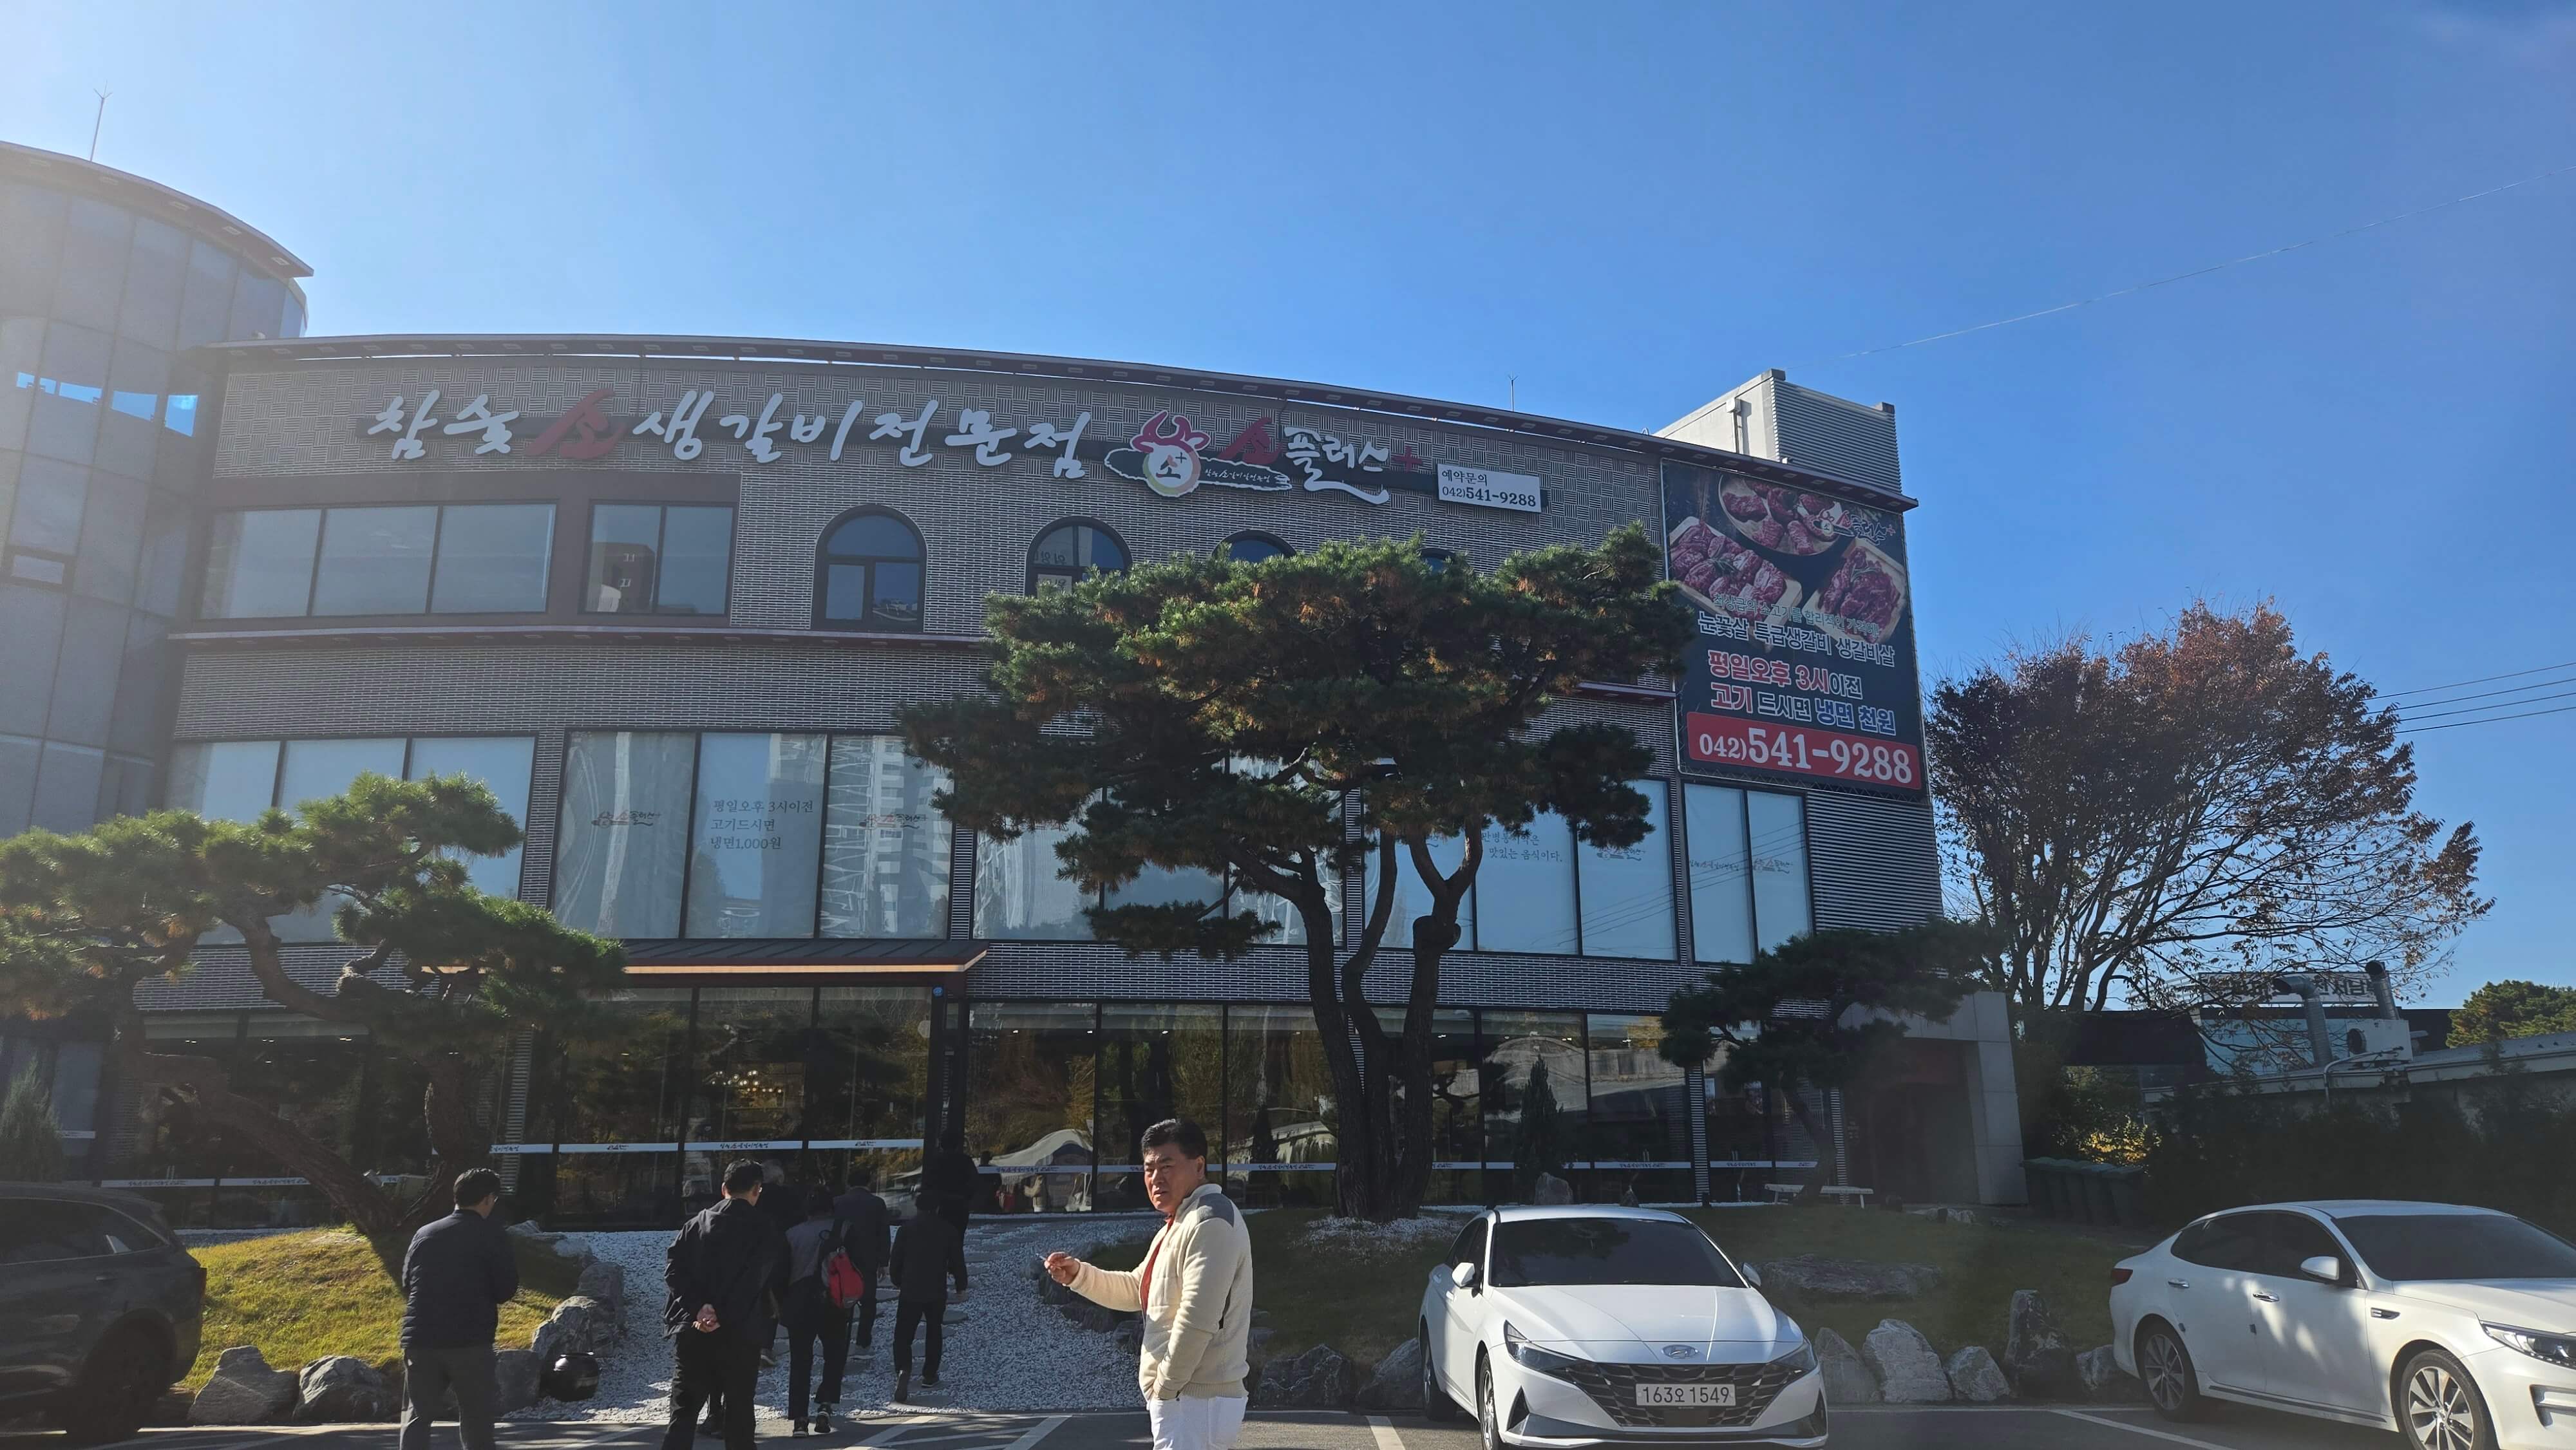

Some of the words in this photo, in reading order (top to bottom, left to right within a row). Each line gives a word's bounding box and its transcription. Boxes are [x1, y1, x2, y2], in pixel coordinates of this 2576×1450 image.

[1441, 469, 1488, 486] 예약문의
[1442, 485, 1537, 507] 042)541-9288
[1759, 601, 1802, 623] 소고기를
[1804, 610, 1845, 630] 합리적인
[1698, 610, 1749, 641] 눈꽃살
[1753, 619, 1832, 656] 특급생갈비
[1835, 635, 1895, 668] 생갈비살
[1707, 649, 1792, 688] 평일오후
[1794, 664, 1863, 701] 3시이전
[1710, 682, 1754, 714] 고기
[1757, 691, 1812, 722] 드시면
[1814, 697, 1855, 730] 냉면
[1857, 704, 1897, 737] 천원
[1700, 727, 1912, 784] 042)541-9288
[714, 799, 765, 813] 평일오후
[768, 800, 813, 813] 3시이전
[711, 818, 775, 832] 고기드시면
[1489, 847, 1518, 860] 맛있는
[1520, 849, 1563, 862] 음식이다.
[1643, 1386, 1685, 1404] 163오
[1689, 1386, 1730, 1404] 1549
